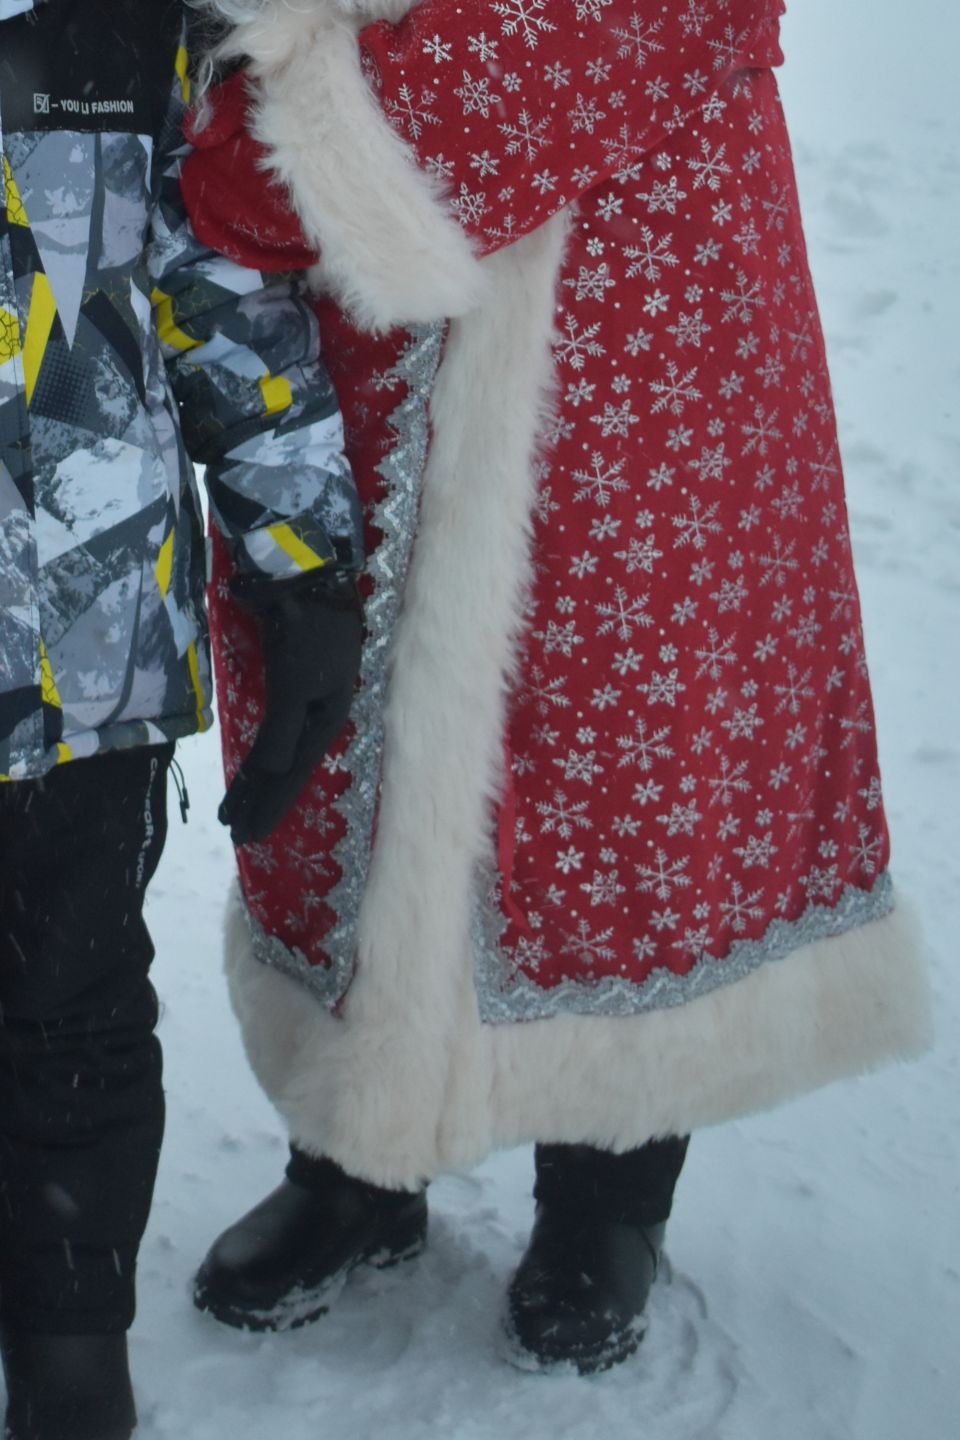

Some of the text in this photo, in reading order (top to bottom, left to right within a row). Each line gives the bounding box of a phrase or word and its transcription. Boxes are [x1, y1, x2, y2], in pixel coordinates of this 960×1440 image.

[60, 99, 80, 112] YOU
[81, 102, 89, 115] LI
[91, 100, 134, 114] FASHION
